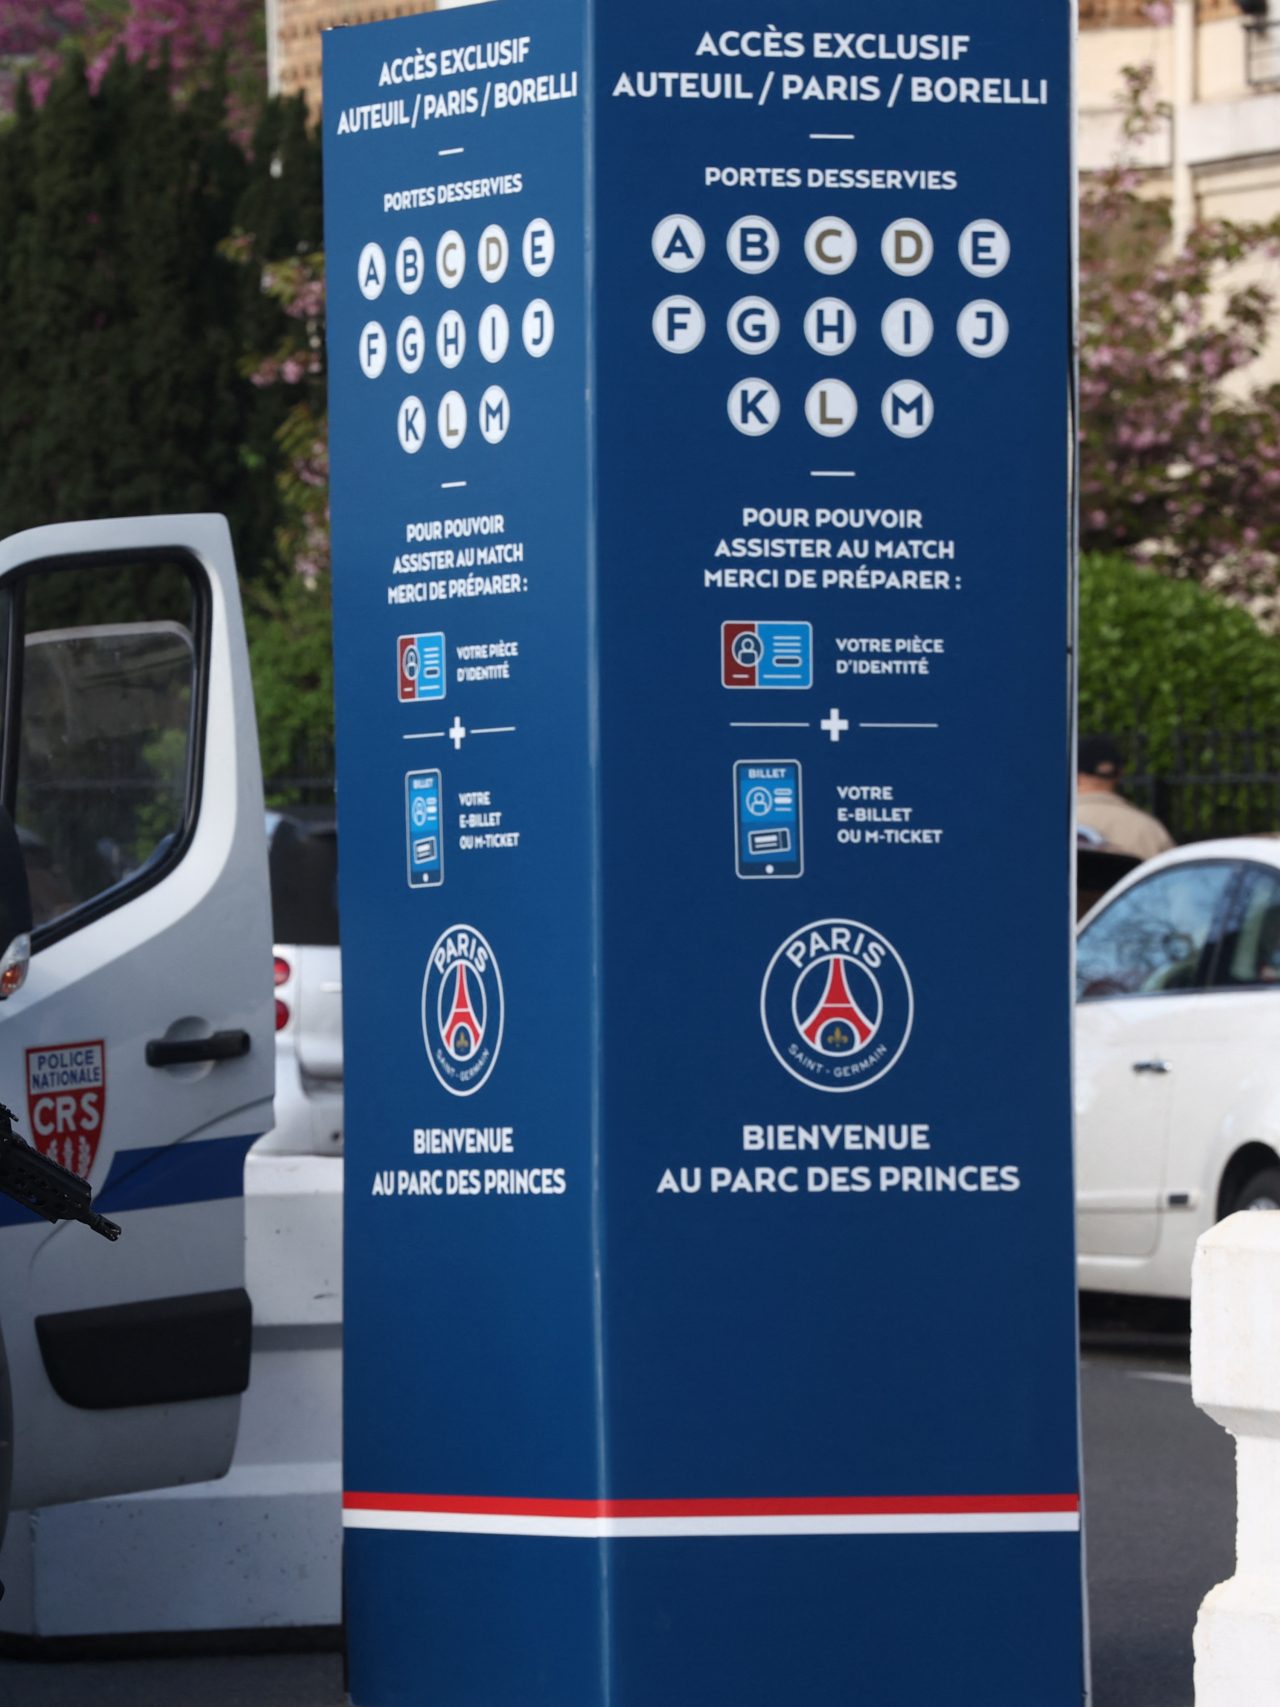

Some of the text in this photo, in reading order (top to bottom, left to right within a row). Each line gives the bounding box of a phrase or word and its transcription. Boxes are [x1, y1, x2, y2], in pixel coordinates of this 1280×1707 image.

[696, 24, 969, 60] ACCÈS EXCLUSIF
[379, 37, 530, 86] ACCÈS EXCLUSIF
[613, 72, 753, 98] AUTEUIL
[783, 75, 880, 101] PARIS
[912, 77, 1047, 104] BORELLI
[337, 100, 410, 134] AUTEUIL
[424, 87, 478, 120] PARIS
[495, 71, 577, 108] BORELLI
[706, 167, 957, 189] PORTES DESSERVIES
[384, 173, 522, 212] PORTES DESSERVIES
[365, 230, 545, 286] A B C D E
[663, 226, 996, 265] A B C D E
[367, 311, 544, 366] F G H I J
[668, 307, 993, 346] F G H I J
[405, 400, 503, 441] K L M
[741, 390, 923, 426] K L M
[407, 515, 504, 542] POUR POUVOIR
[743, 508, 922, 528] POUR POUVOIR
[393, 543, 523, 573] ASSISTER AU MATCH
[715, 538, 954, 559] ASSISTER AU MATCH
[388, 583, 427, 604] MERCI
[429, 581, 447, 600] DE
[449, 573, 521, 598] PRÉPARER
[705, 569, 778, 588] MERCI
[785, 569, 817, 588] DE
[823, 565, 949, 589] PRÉPARER
[457, 640, 518, 660] VOTRE PIÈCE
[836, 636, 944, 653] VOTRE PIÈCE
[748, 769, 786, 778] BILLET
[459, 791, 490, 806] VOTRE
[837, 786, 893, 800] VOTRE
[459, 812, 501, 828] E-BILLET
[838, 808, 912, 821] E-BILLET
[460, 832, 519, 849] OU M-TICKET
[837, 829, 942, 843] OU M-TICKET
[434, 933, 488, 974] PARIS
[786, 927, 886, 968] PARIS
[38, 1050, 94, 1071] POLICE
[788, 1043, 823, 1074] SAINT
[833, 1044, 887, 1077] GERMAIN
[32, 1067, 100, 1089] NATIONALE
[33, 1092, 100, 1136] CRS
[414, 1127, 513, 1154] BIENVENUE
[743, 1124, 930, 1150] BIENVENUE
[372, 1168, 566, 1195] AU PARC DES PRINCES
[657, 1166, 1020, 1193] AU PARC DES PRINCES
